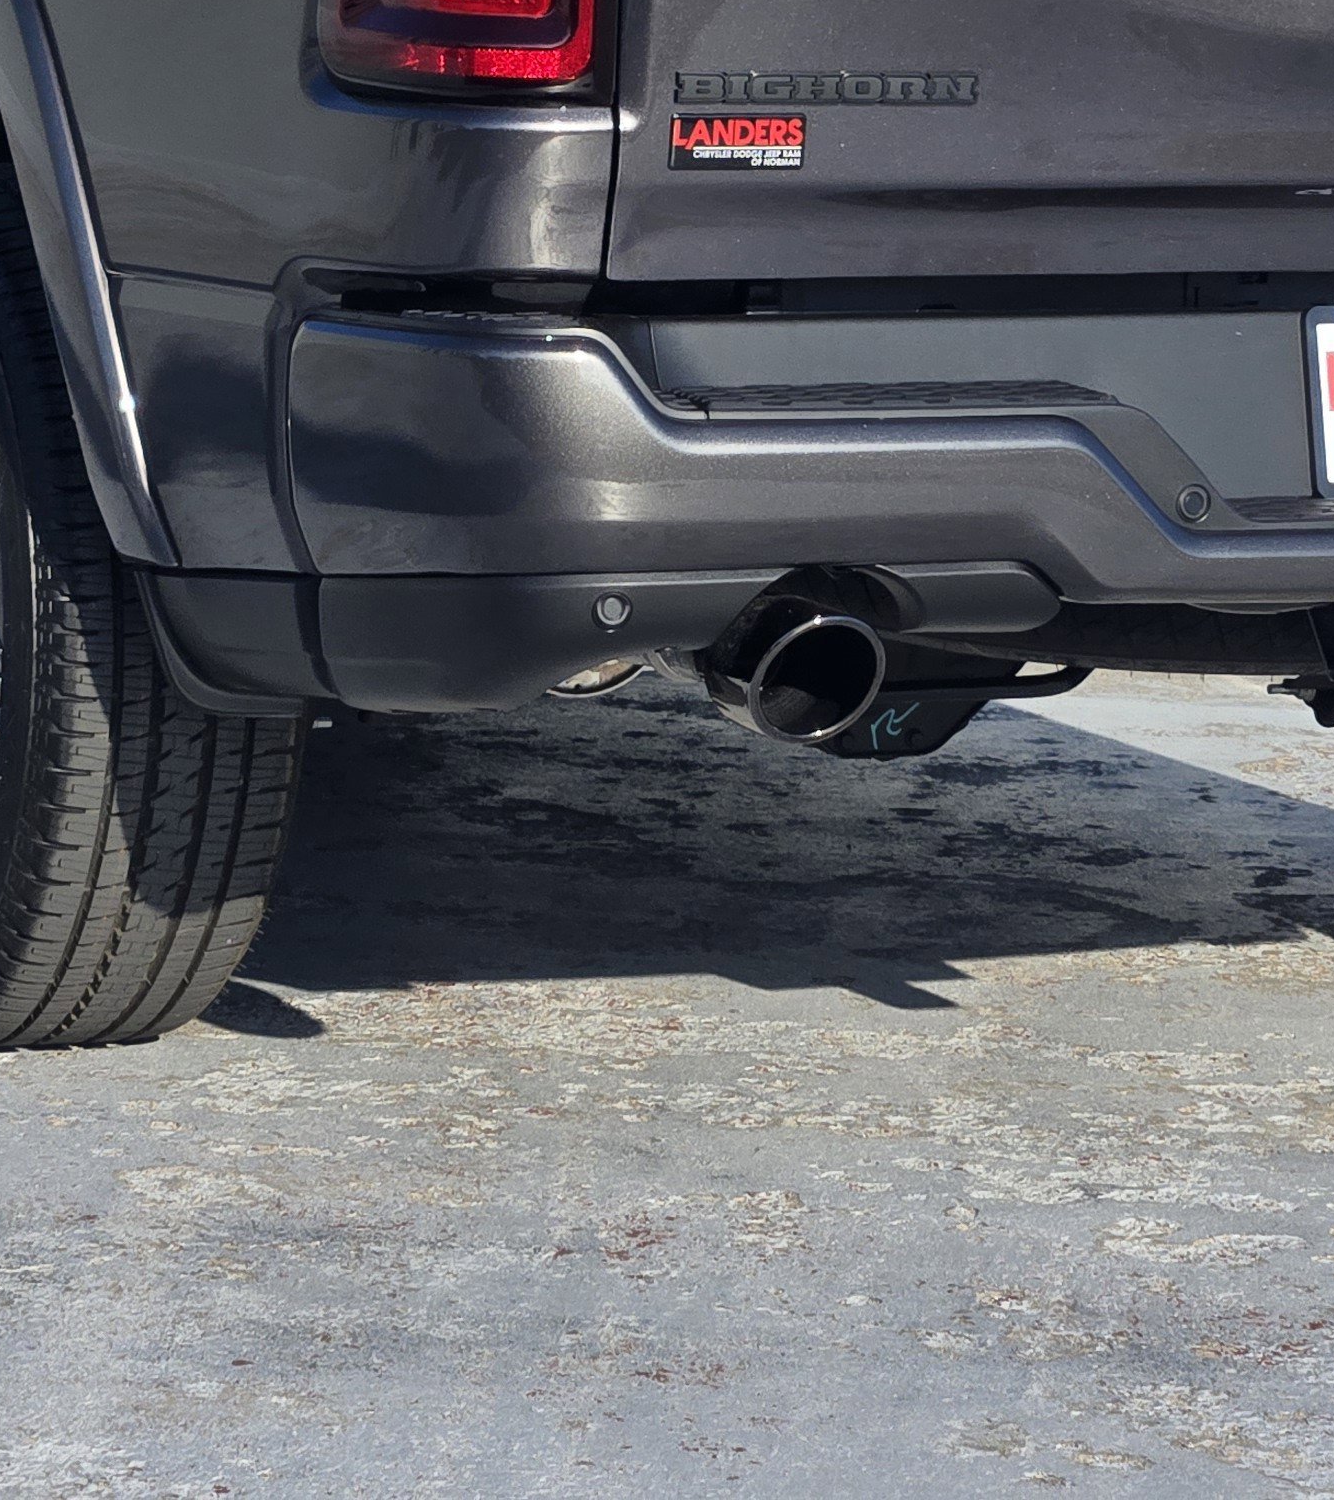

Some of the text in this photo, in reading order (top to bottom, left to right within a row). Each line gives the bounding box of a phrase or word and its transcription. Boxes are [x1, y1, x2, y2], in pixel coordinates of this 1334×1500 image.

[673, 118, 804, 150] LANDERS
[692, 150, 732, 159] CHRYSLER
[733, 149, 763, 159] DODGE
[783, 149, 802, 158] RAM
